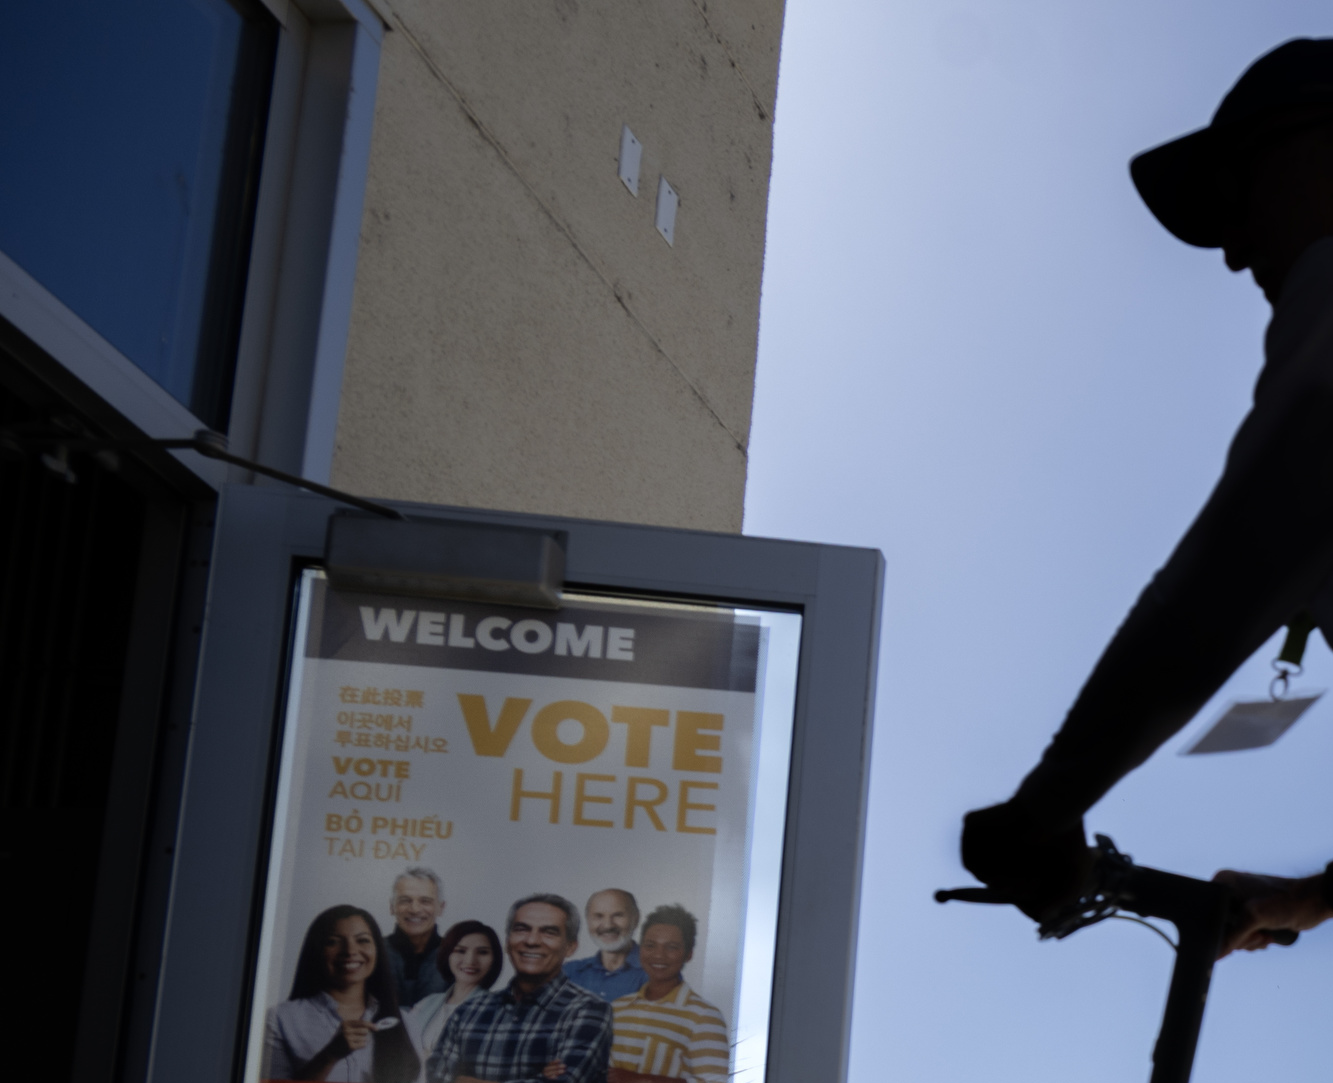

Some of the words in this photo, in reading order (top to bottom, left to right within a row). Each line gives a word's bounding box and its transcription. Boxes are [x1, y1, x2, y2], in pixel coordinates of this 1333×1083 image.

[359, 606, 636, 661] WELCOME
[336, 710, 413, 733] 이곳에서
[456, 693, 725, 774] VOTE
[335, 730, 449, 753] 투표하십시오
[331, 755, 411, 779] VOTE
[327, 779, 403, 803] AQUÍ
[509, 768, 720, 835] HERE
[325, 808, 364, 834] BỎ
[371, 814, 454, 839] PHIẾU
[323, 836, 365, 861] TẠI
[372, 838, 428, 861] ĐÂY
